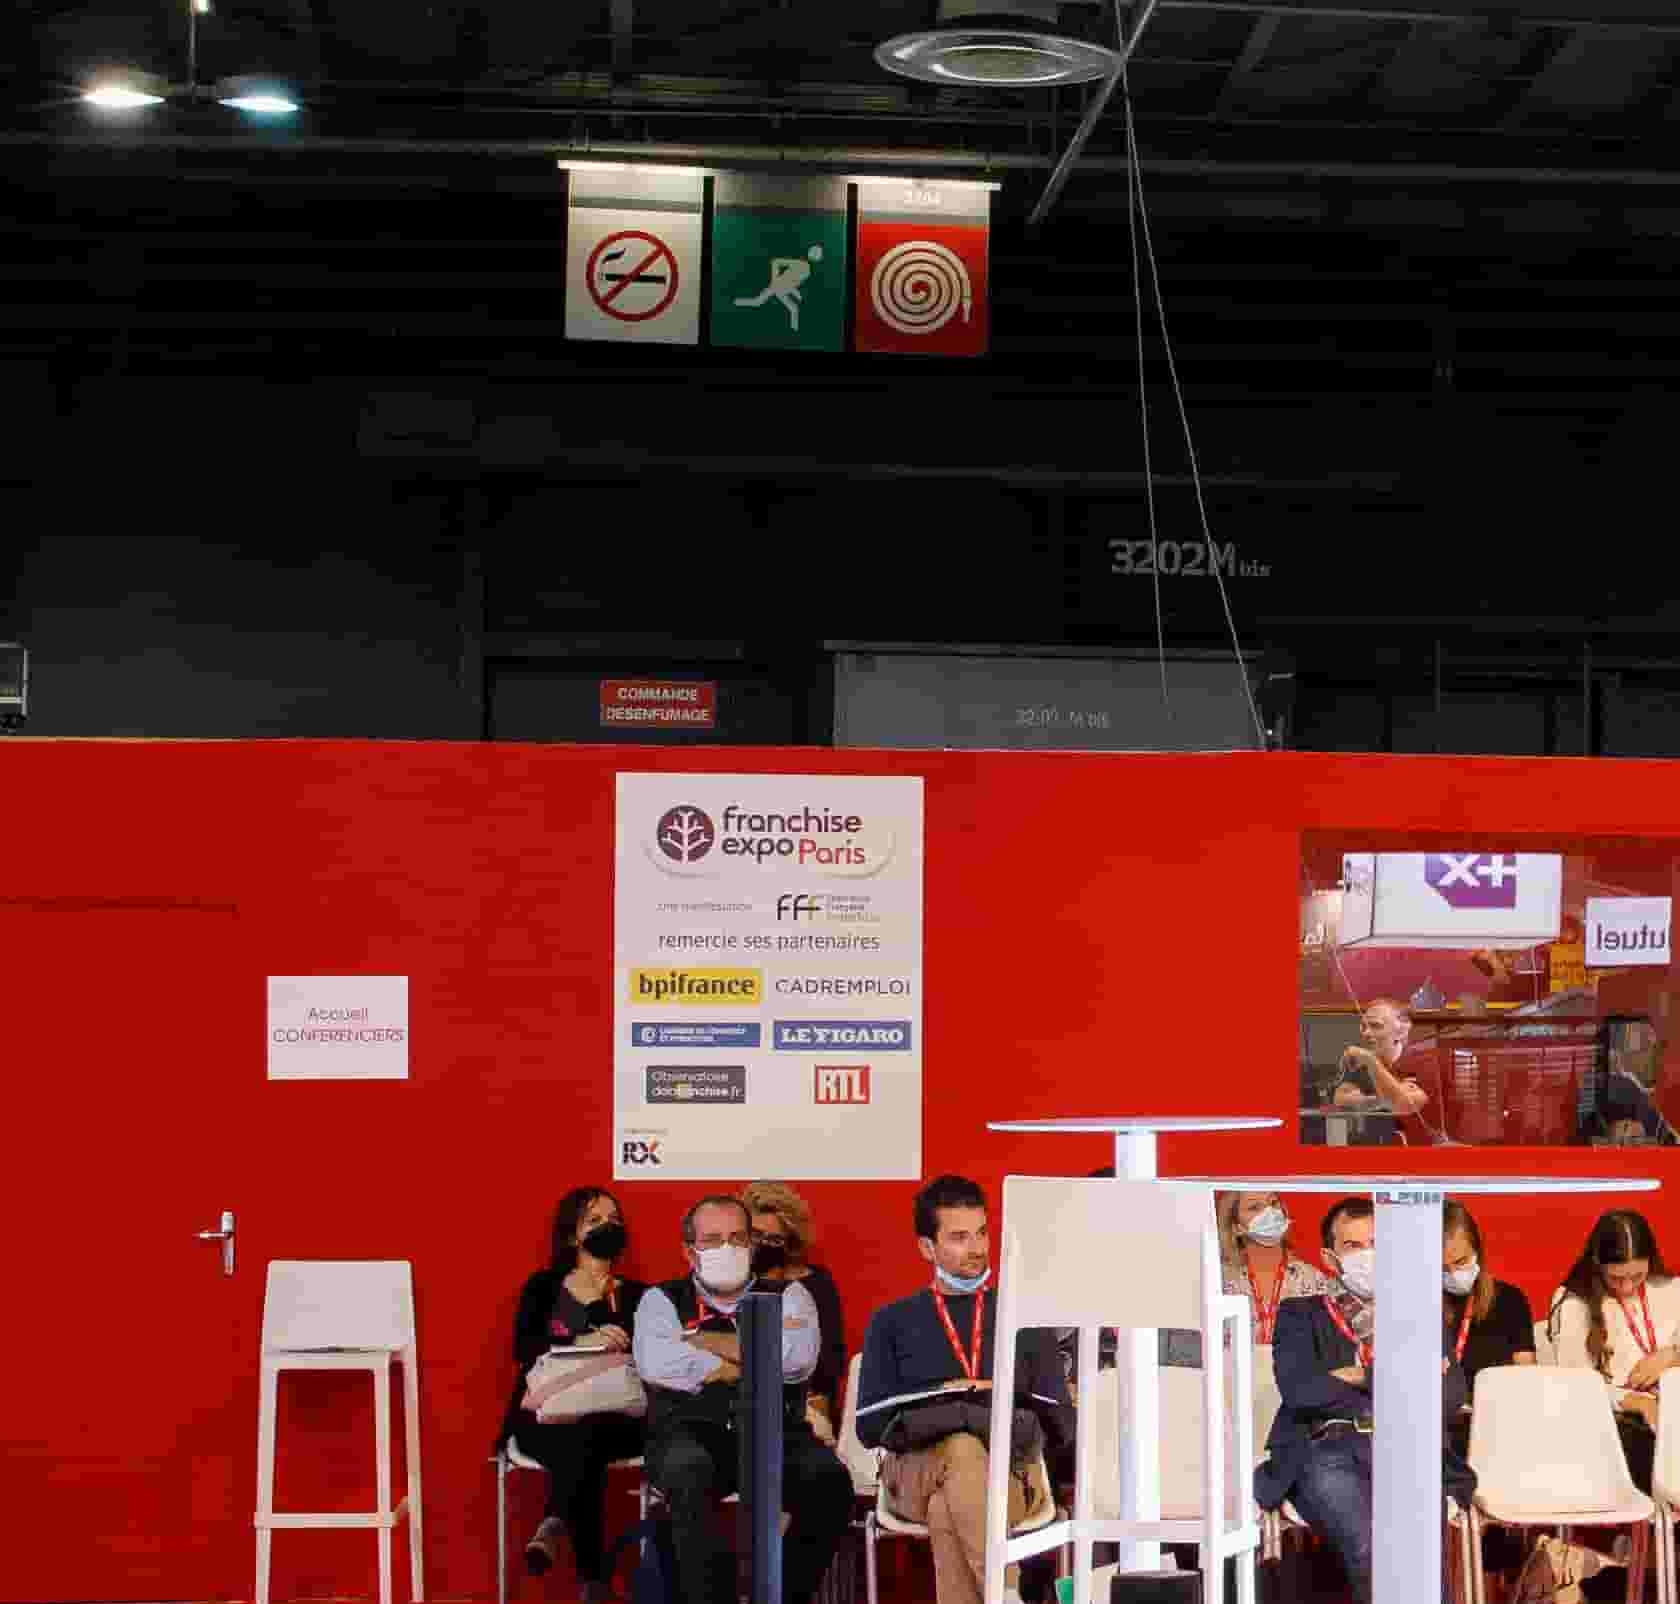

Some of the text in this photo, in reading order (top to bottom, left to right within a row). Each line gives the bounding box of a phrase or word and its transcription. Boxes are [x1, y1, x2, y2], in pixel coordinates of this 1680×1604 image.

[722, 805, 864, 833] franchise
[721, 837, 866, 865] expo Paris
[657, 928, 880, 952] remercie ses partenaires
[639, 970, 755, 999] bpifrance
[776, 979, 911, 996] CADREMPLOI
[781, 1027, 904, 1044] LE FIGARO
[818, 1069, 868, 1102] RTL
